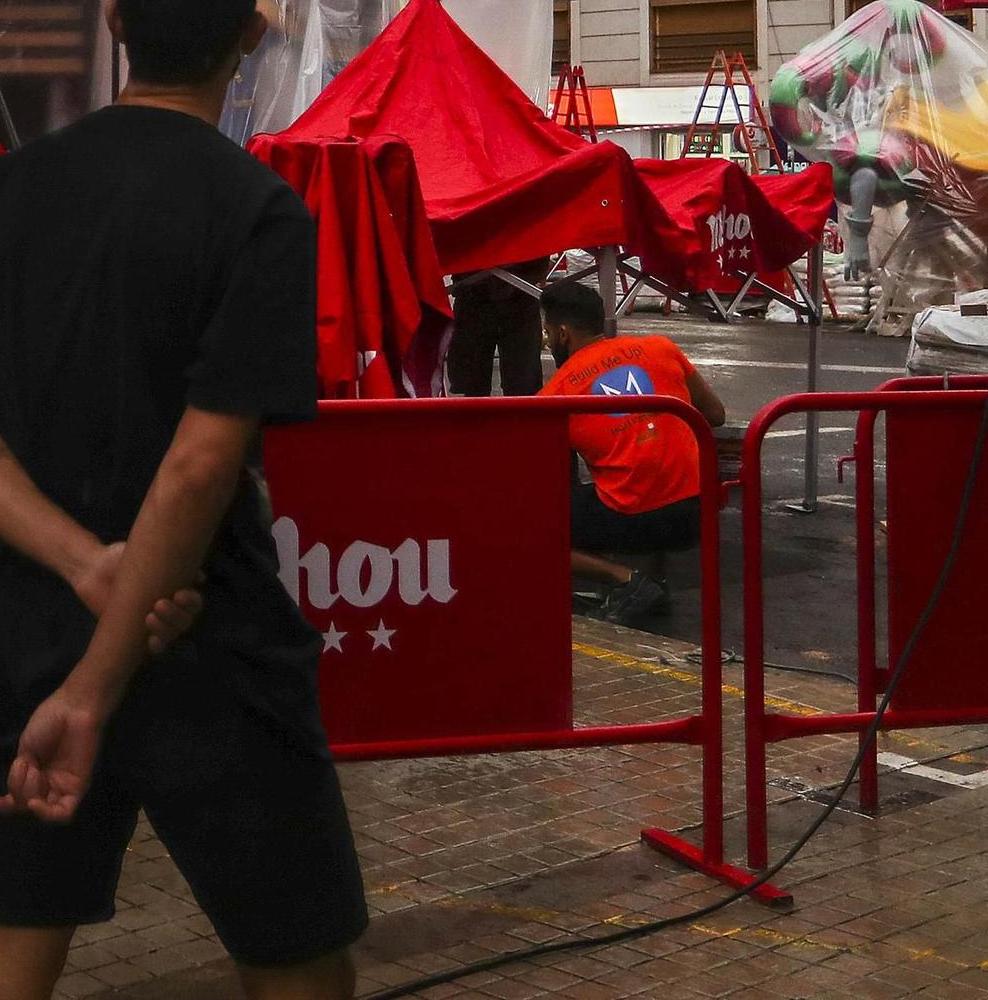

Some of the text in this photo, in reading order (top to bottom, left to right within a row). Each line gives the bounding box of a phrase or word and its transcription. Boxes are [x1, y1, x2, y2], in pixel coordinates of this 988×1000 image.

[569, 364, 600, 385] Build
[600, 355, 621, 369] Me
[271, 516, 458, 610] hou
